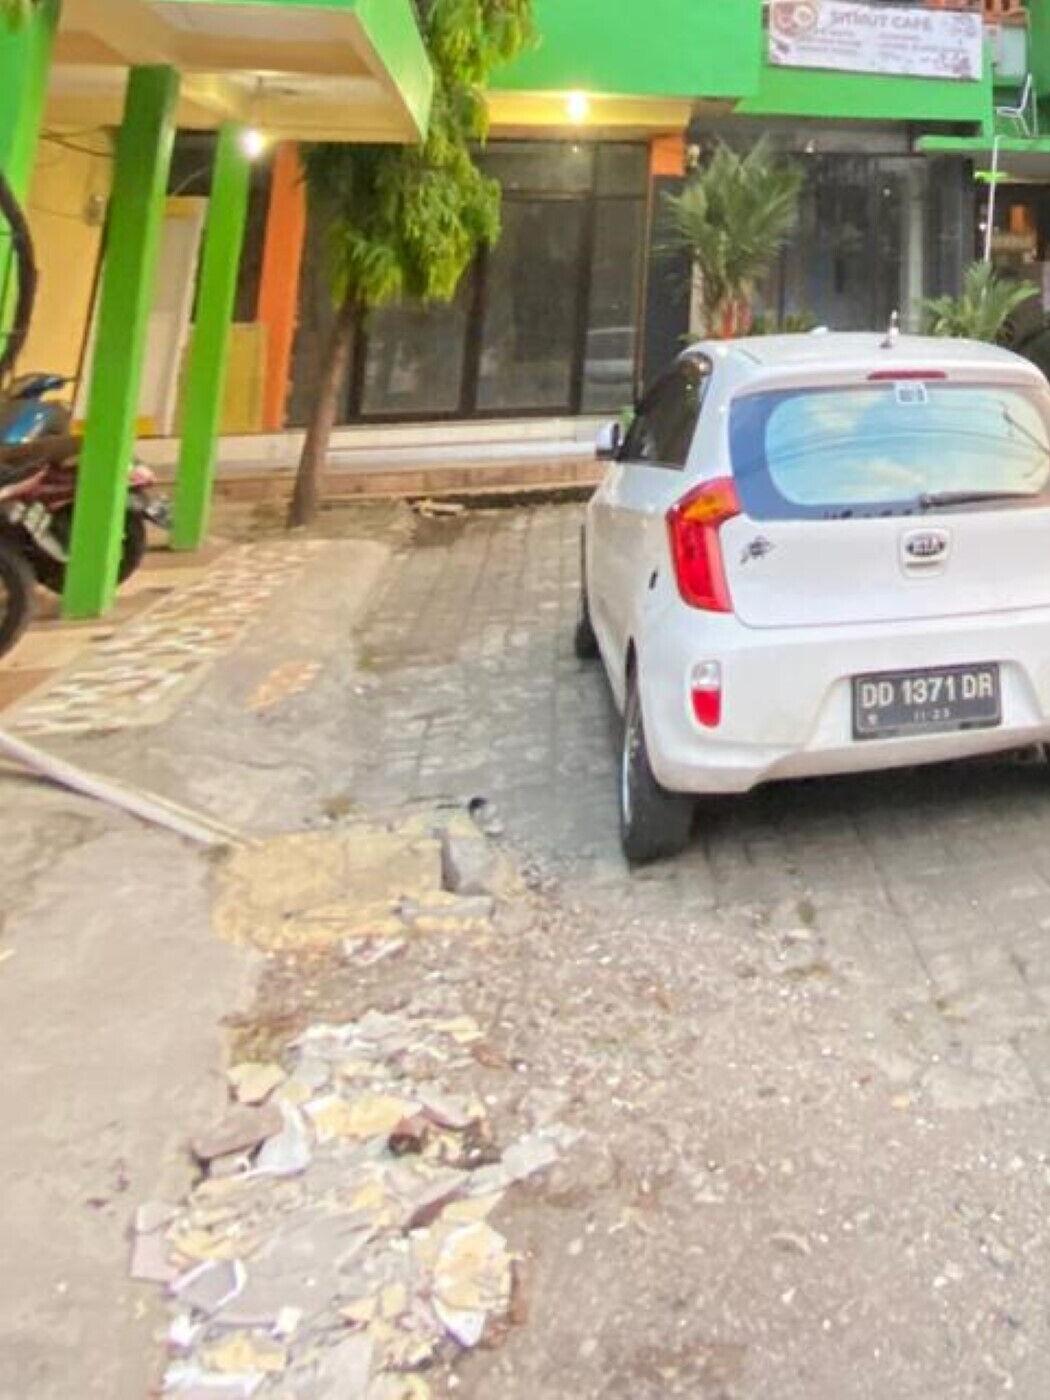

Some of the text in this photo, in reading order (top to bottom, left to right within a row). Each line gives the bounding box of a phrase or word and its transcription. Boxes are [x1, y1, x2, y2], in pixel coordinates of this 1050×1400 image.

[861, 671, 994, 709] DD 1371 DR
